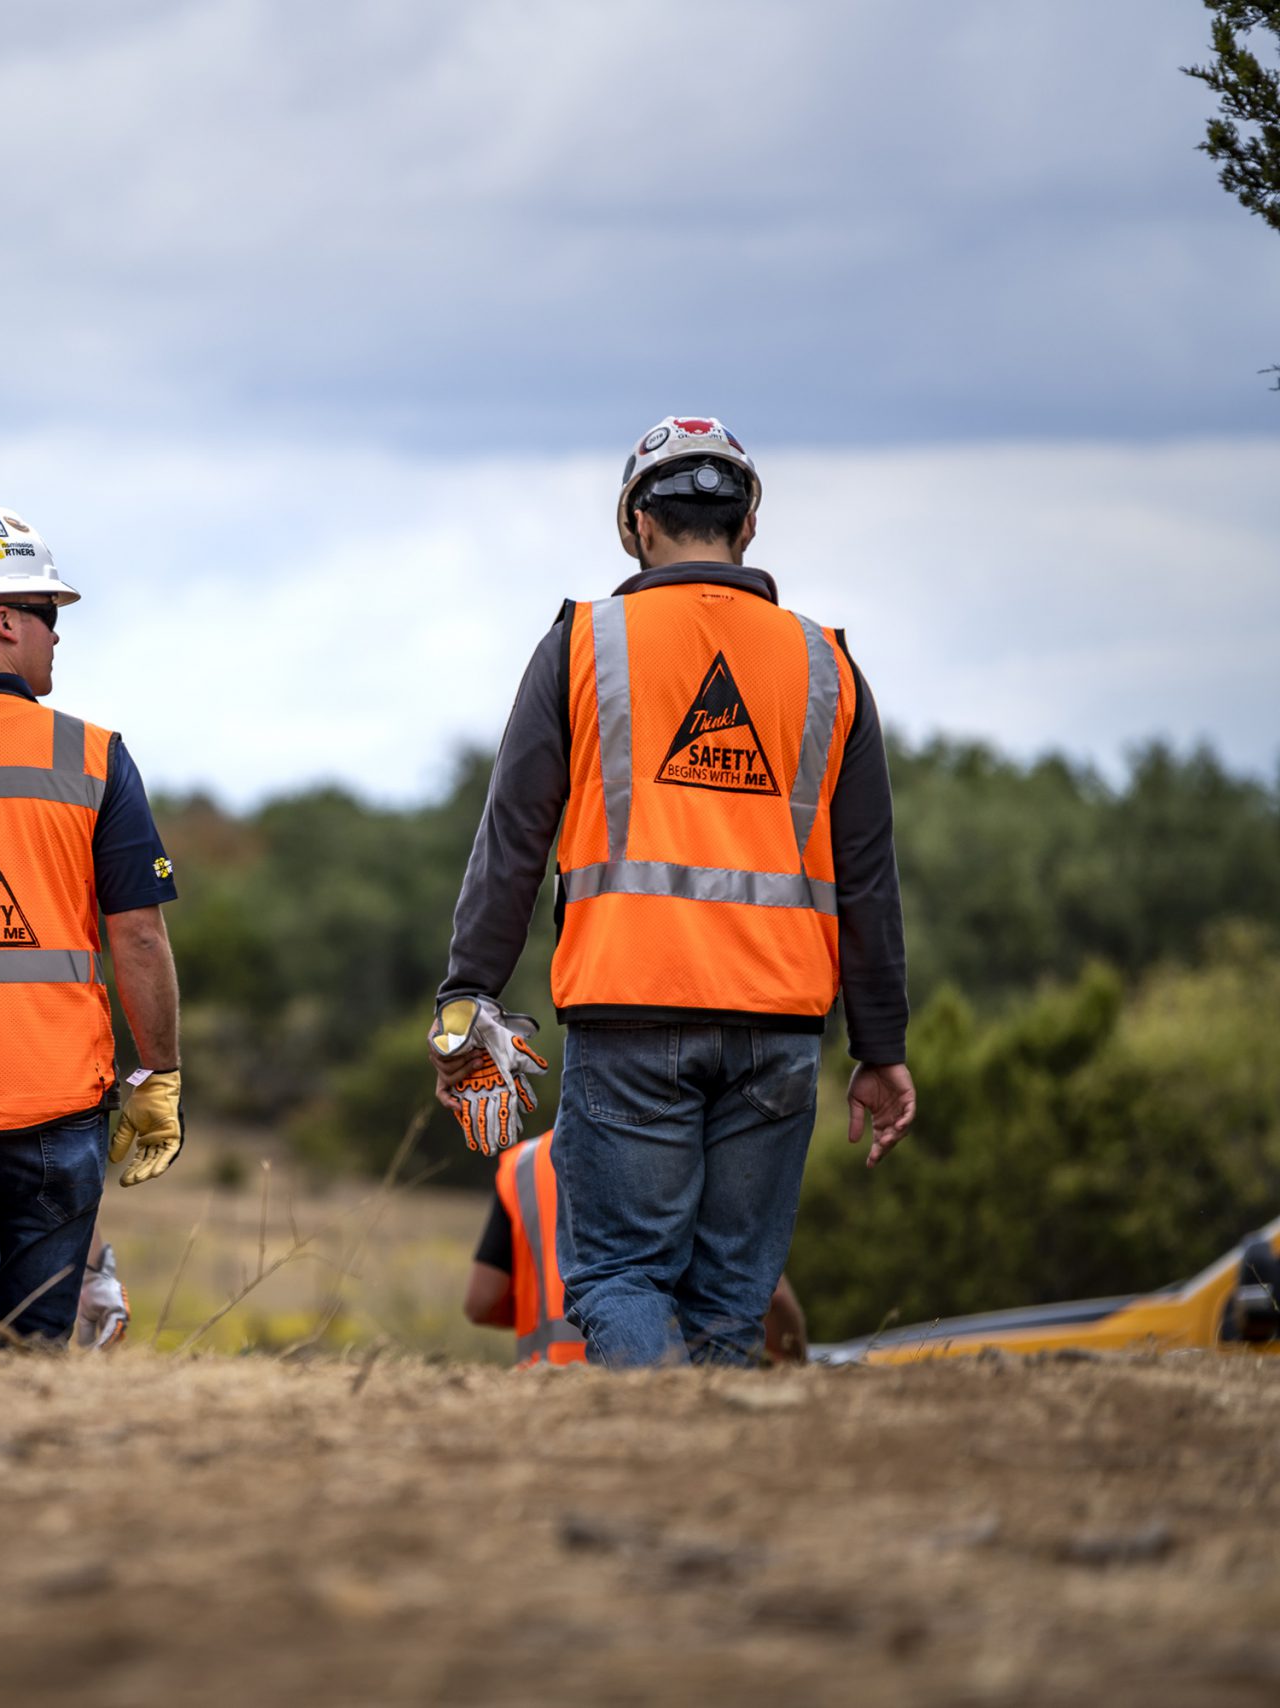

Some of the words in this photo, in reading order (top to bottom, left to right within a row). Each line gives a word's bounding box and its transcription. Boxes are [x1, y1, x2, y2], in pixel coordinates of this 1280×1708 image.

[689, 703, 739, 734] Think!
[689, 744, 758, 771] SAFETY
[668, 764, 707, 780] BEGINS
[710, 770, 740, 784] WITH
[744, 773, 767, 786] ME
[4, 927, 26, 939] ME
